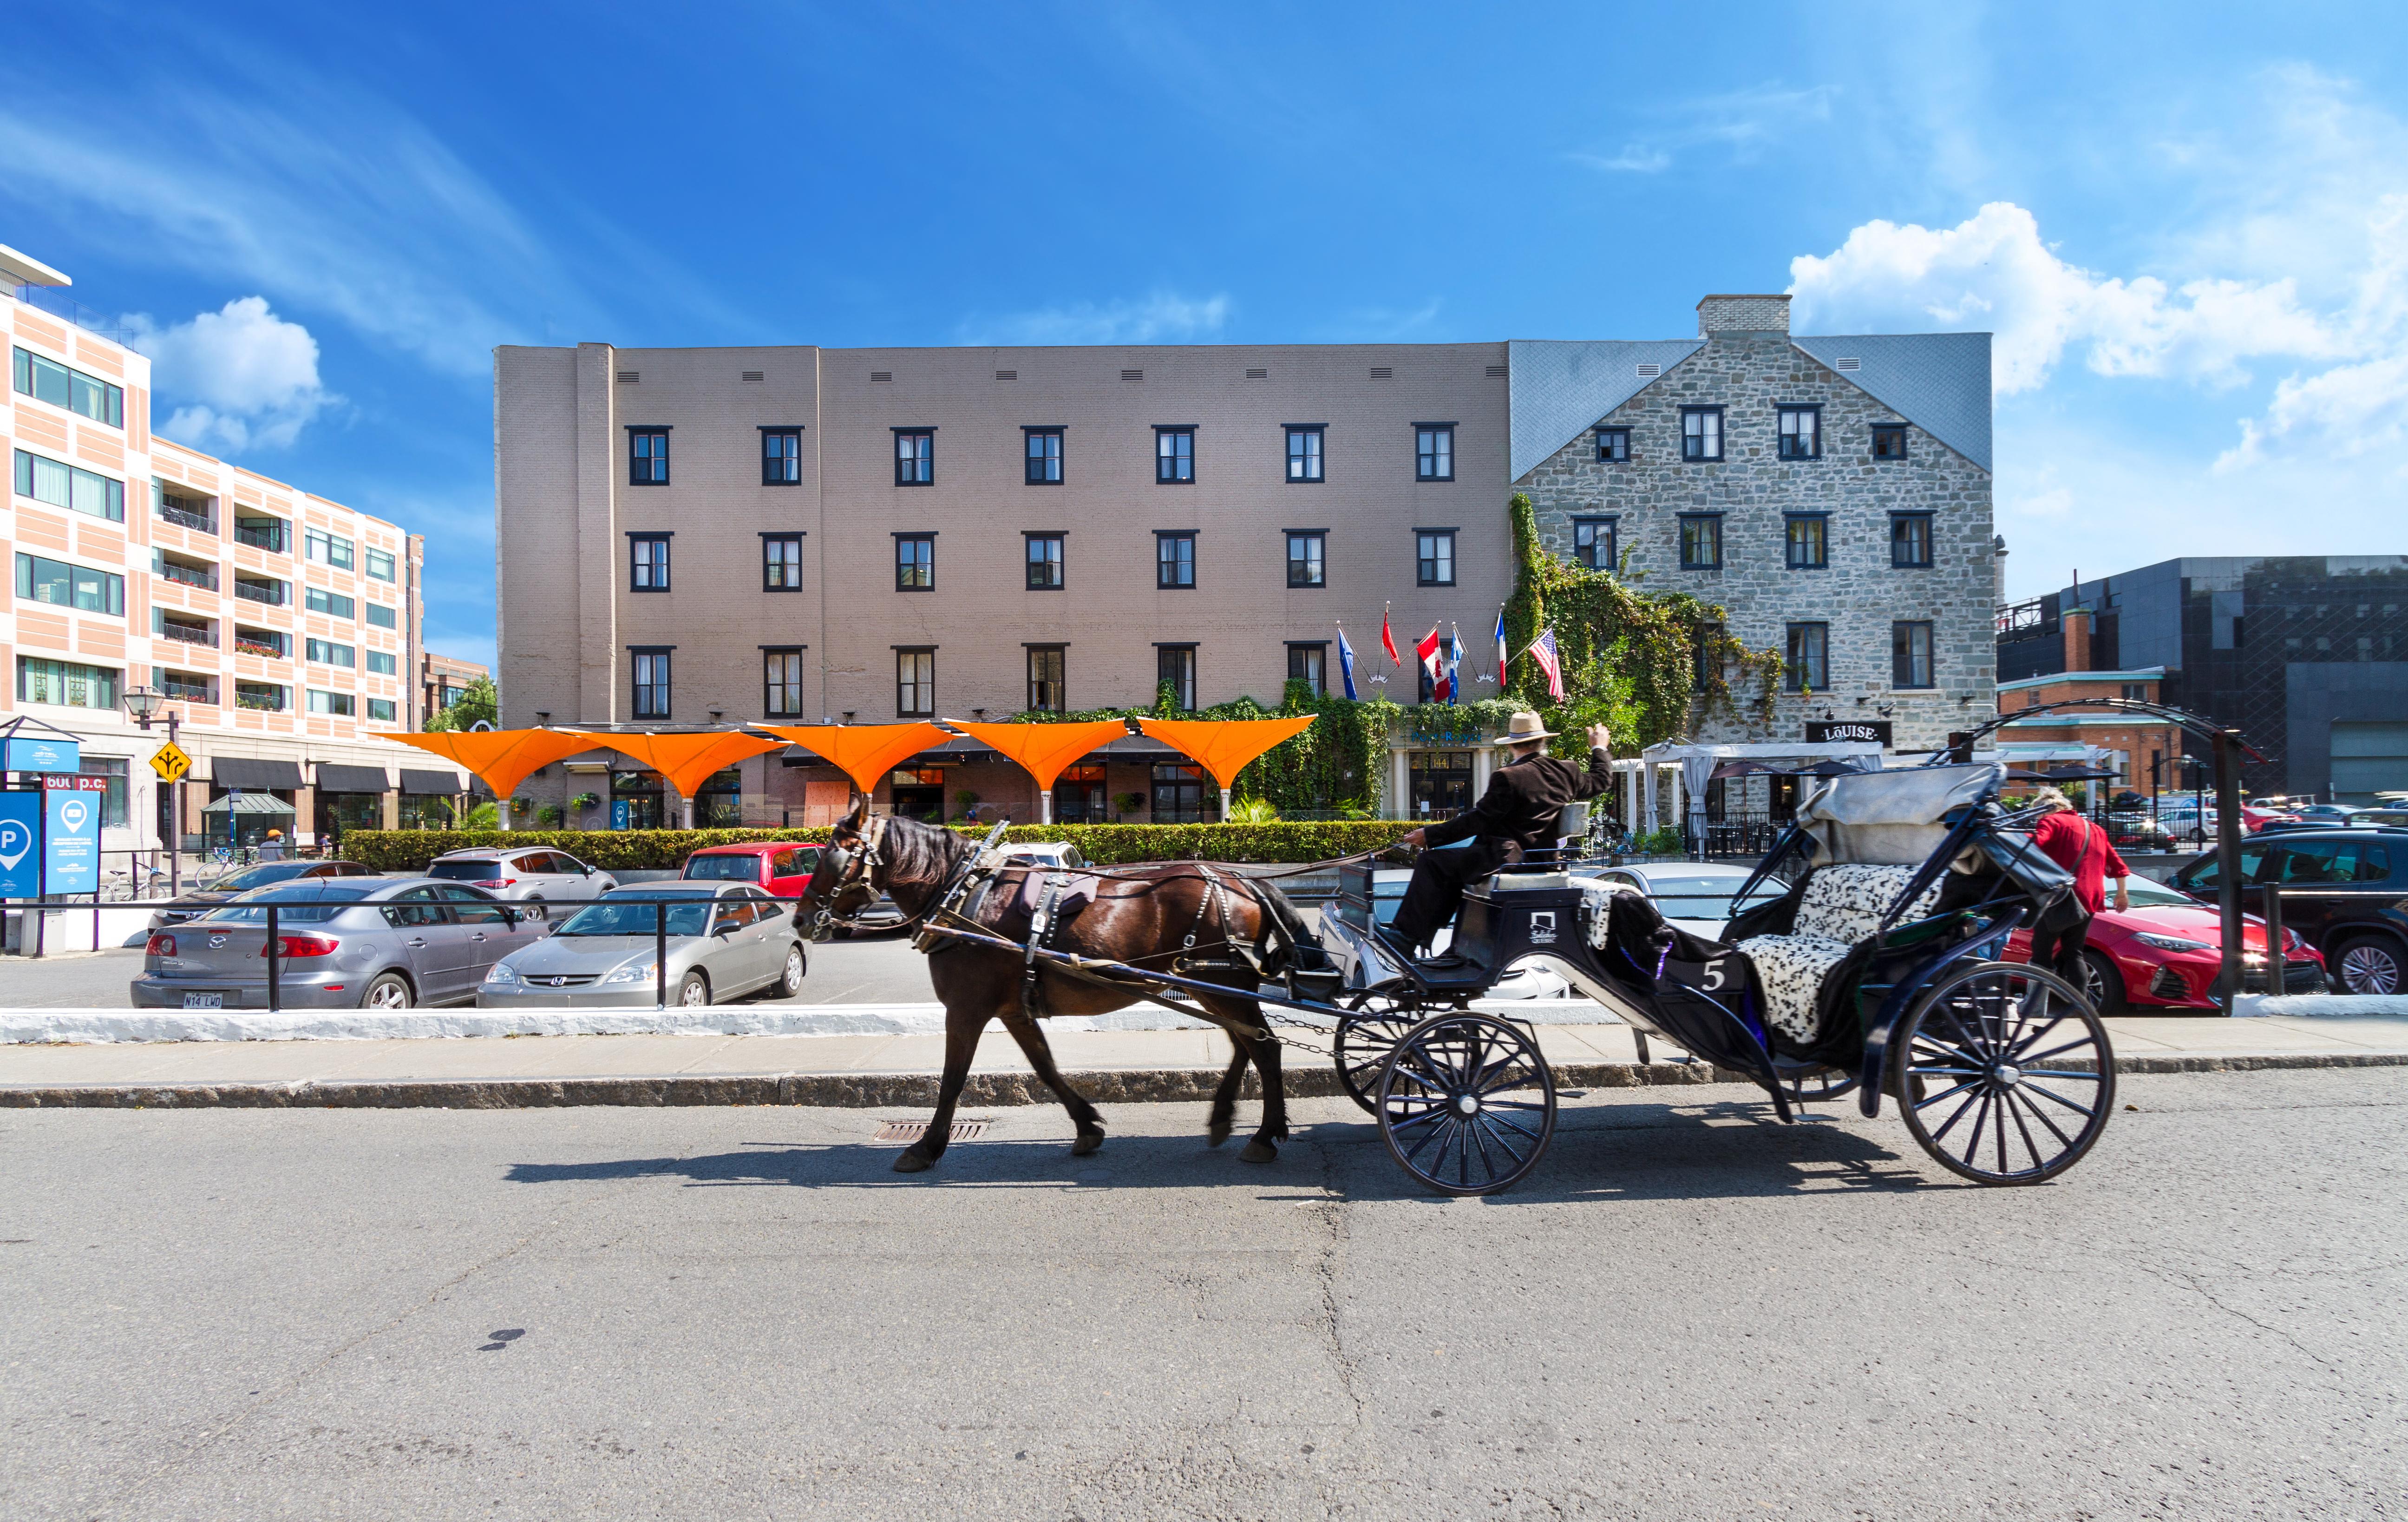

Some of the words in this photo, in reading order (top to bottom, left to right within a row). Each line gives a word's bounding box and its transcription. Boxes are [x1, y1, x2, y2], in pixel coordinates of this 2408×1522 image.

[1433, 758, 1447, 768] 144
[1, 831, 17, 848] P
[1701, 959, 1725, 991] 5
[185, 997, 201, 1006] N14
[205, 997, 221, 1007] LWD
